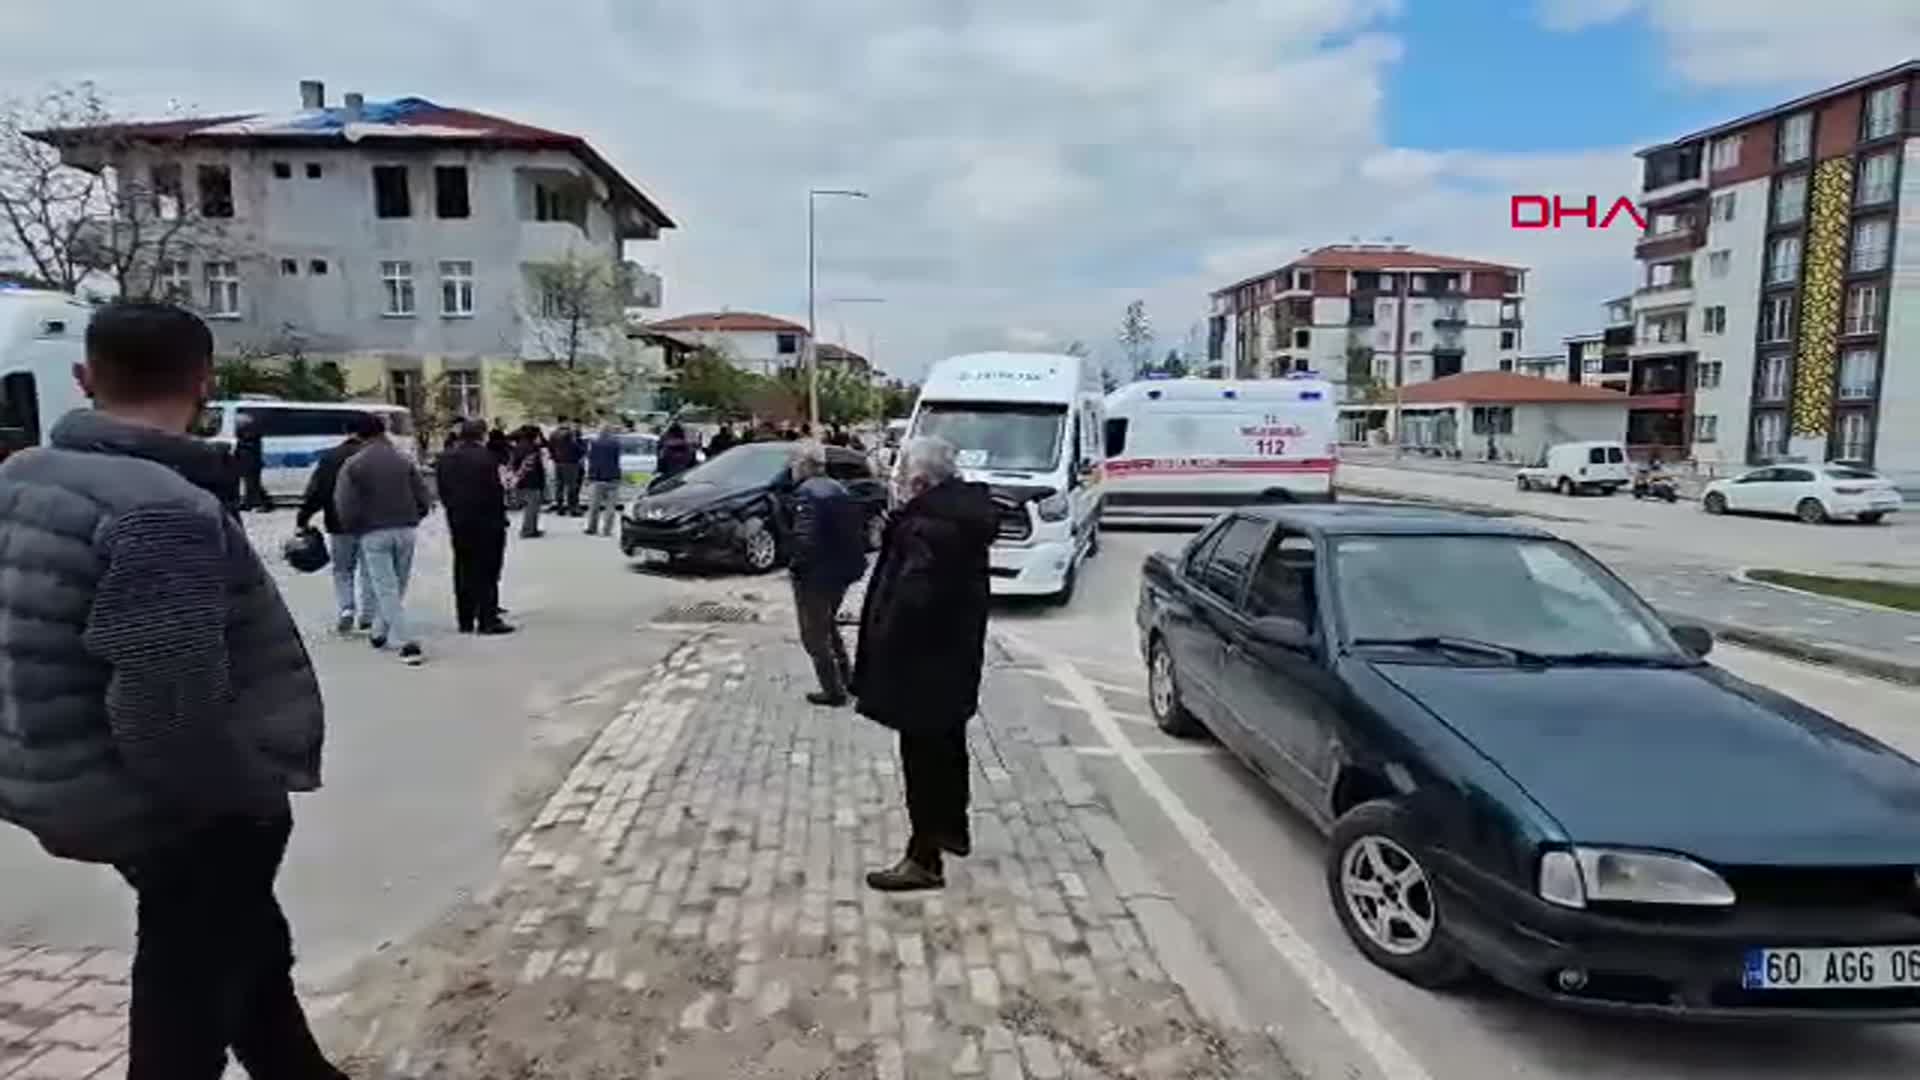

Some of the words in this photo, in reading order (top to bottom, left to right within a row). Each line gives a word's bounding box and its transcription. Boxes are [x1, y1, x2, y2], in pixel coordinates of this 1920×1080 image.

[1256, 440, 1286, 455] 112
[1767, 952, 1800, 983] 60
[1825, 951, 1874, 983] AGG
